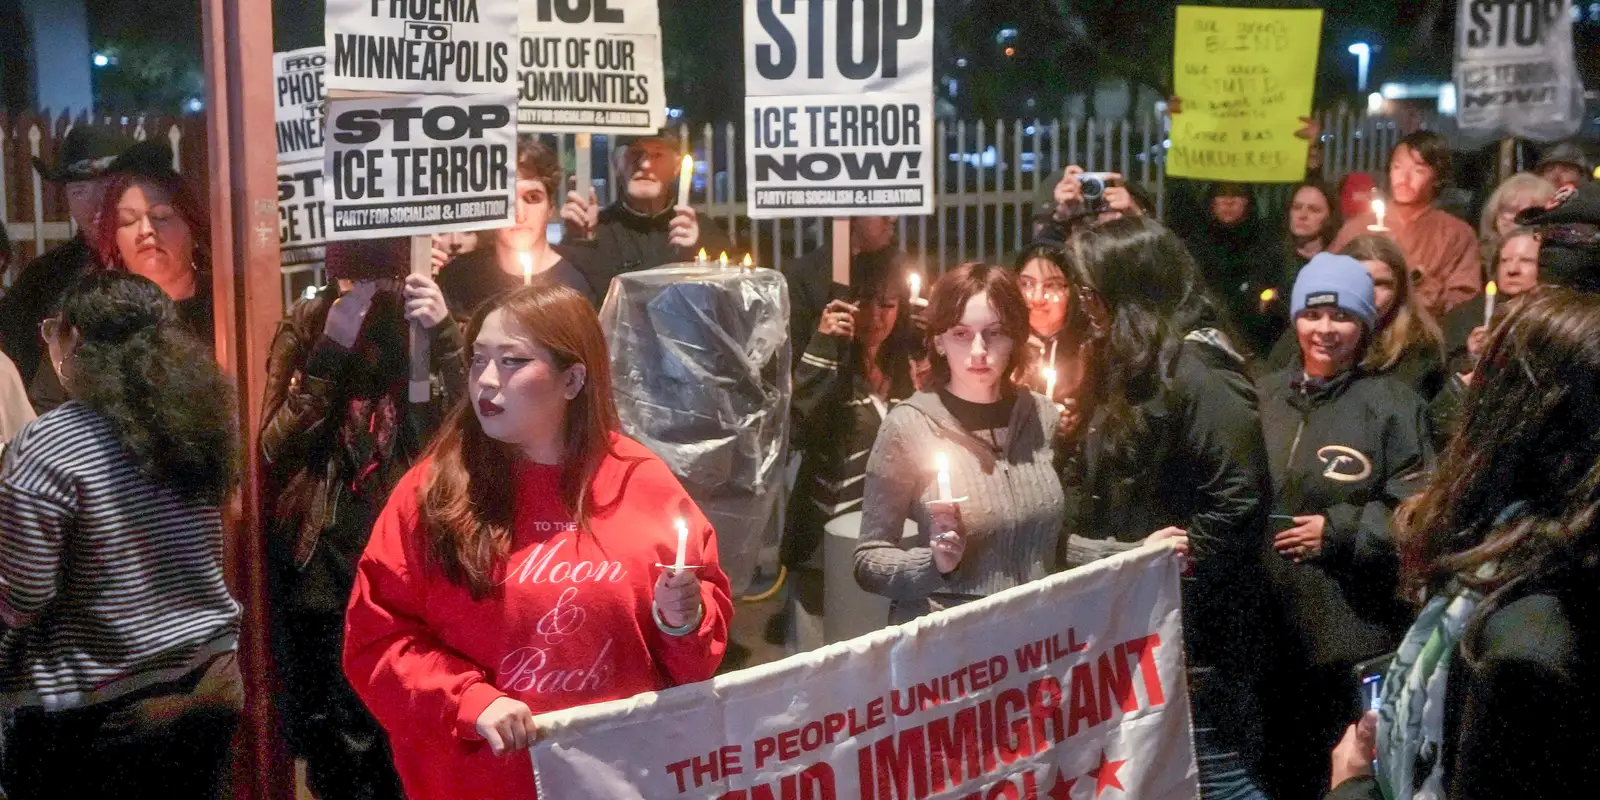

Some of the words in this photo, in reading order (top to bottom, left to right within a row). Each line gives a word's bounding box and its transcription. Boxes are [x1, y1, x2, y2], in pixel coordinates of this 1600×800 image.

[409, 24, 448, 41] TO
[520, 37, 561, 68] OUT
[566, 37, 591, 68] OF
[595, 39, 634, 71] OUR
[755, 0, 923, 80] STOP
[334, 33, 508, 84] MINNEAPOLIS
[333, 105, 510, 144] STOP
[754, 106, 799, 148] ICE
[805, 103, 921, 148] TERROR
[333, 149, 384, 200] ICE
[391, 144, 508, 197] TERROR
[755, 151, 922, 182] NOW!
[336, 208, 369, 227] PARTY
[369, 208, 390, 224] FOR
[390, 205, 441, 223] SOCIALISM
[442, 204, 454, 221] &
[455, 200, 506, 218] LIBERATION
[757, 191, 787, 205] PARTY
[787, 191, 804, 204] FOR
[805, 190, 853, 204] SOCIALISM
[855, 190, 867, 204] &
[868, 189, 921, 204] LIBERATION
[534, 522, 551, 532] TO
[553, 521, 578, 531] THE
[496, 538, 628, 586] Moon
[500, 638, 612, 694] Back
[665, 745, 743, 793] THE
[754, 697, 885, 769] PEOPLE
[890, 655, 1009, 717] UNITED
[1015, 627, 1088, 672] WILL
[858, 633, 1165, 800] IMMIGRANT
